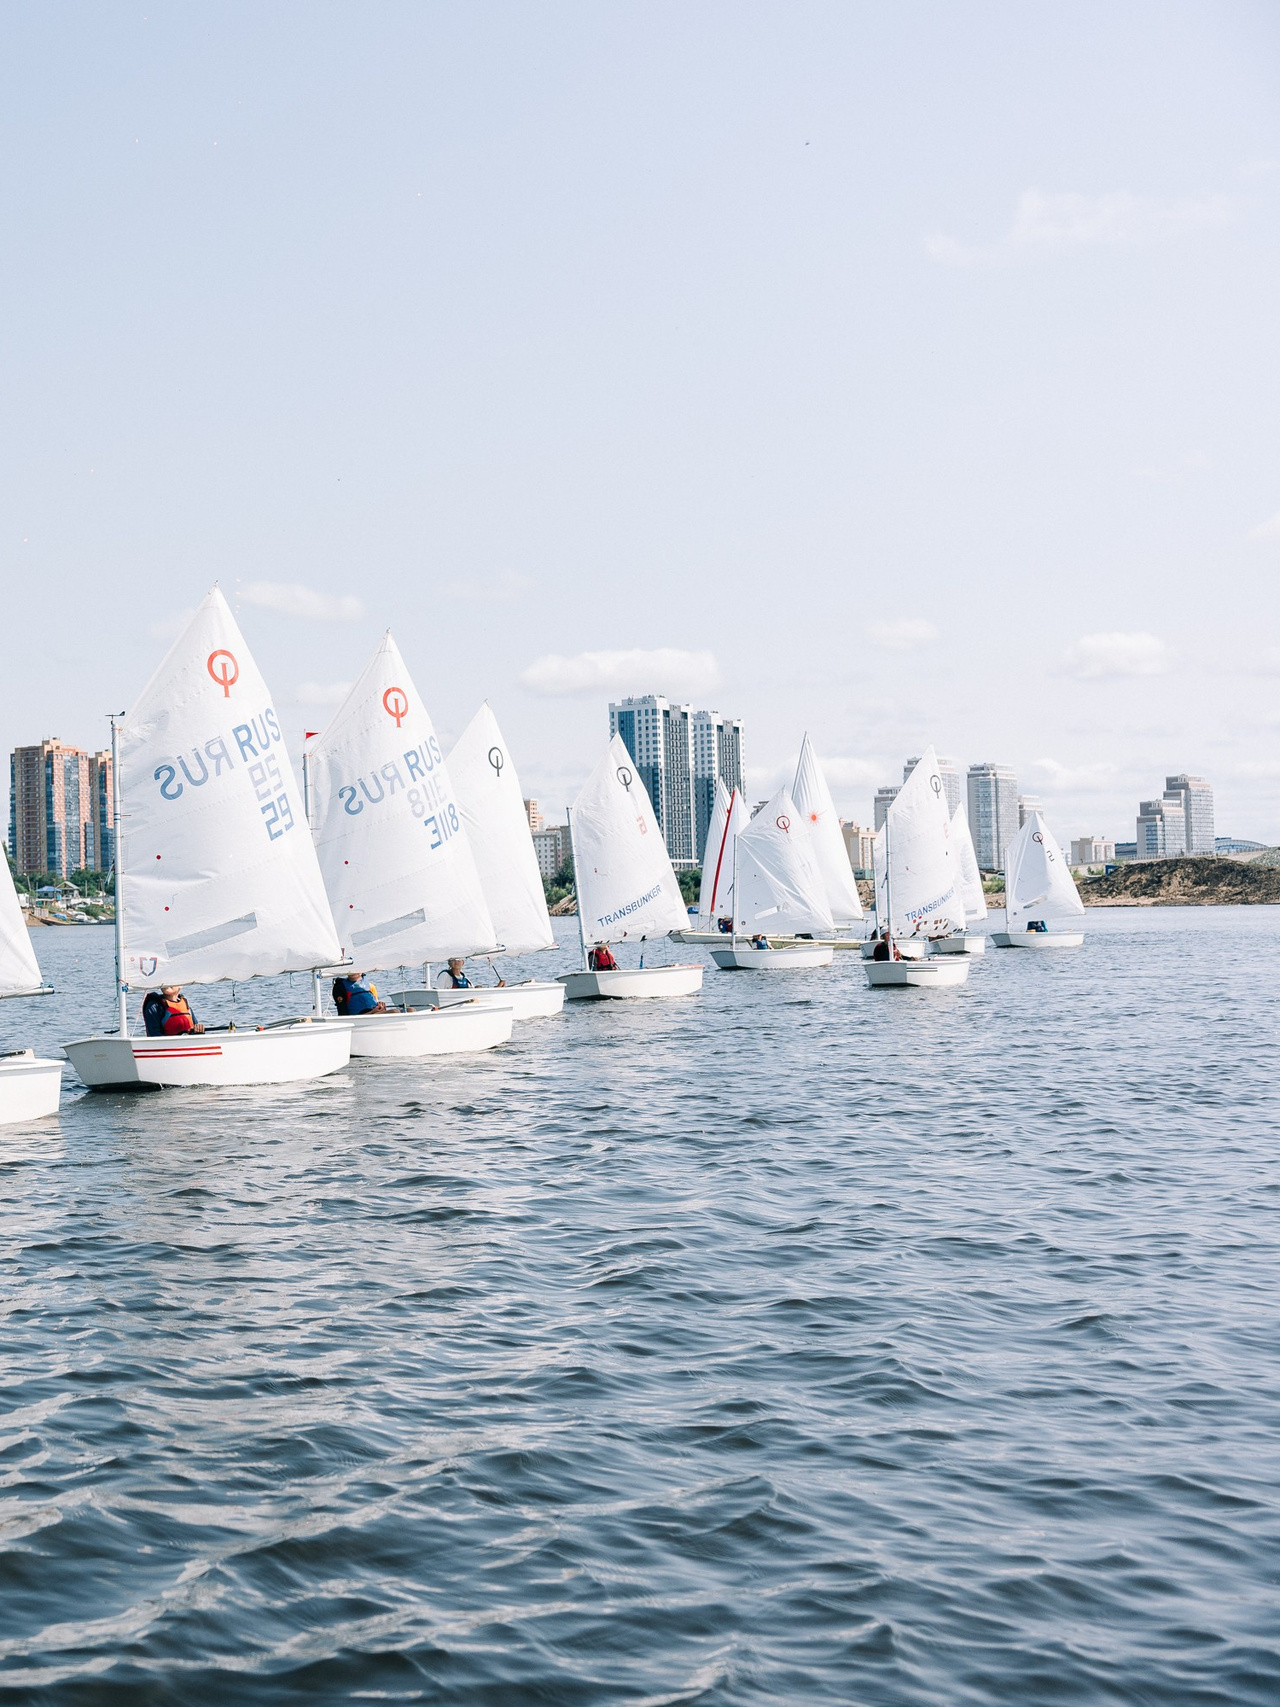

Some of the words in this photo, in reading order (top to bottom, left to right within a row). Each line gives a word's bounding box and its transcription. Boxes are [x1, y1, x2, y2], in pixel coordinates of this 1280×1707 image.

[232, 708, 281, 762] RUS
[403, 735, 442, 782] RUS
[597, 884, 663, 928] TRANSBUNKER
[904, 887, 955, 923] TRANSBUNKER
